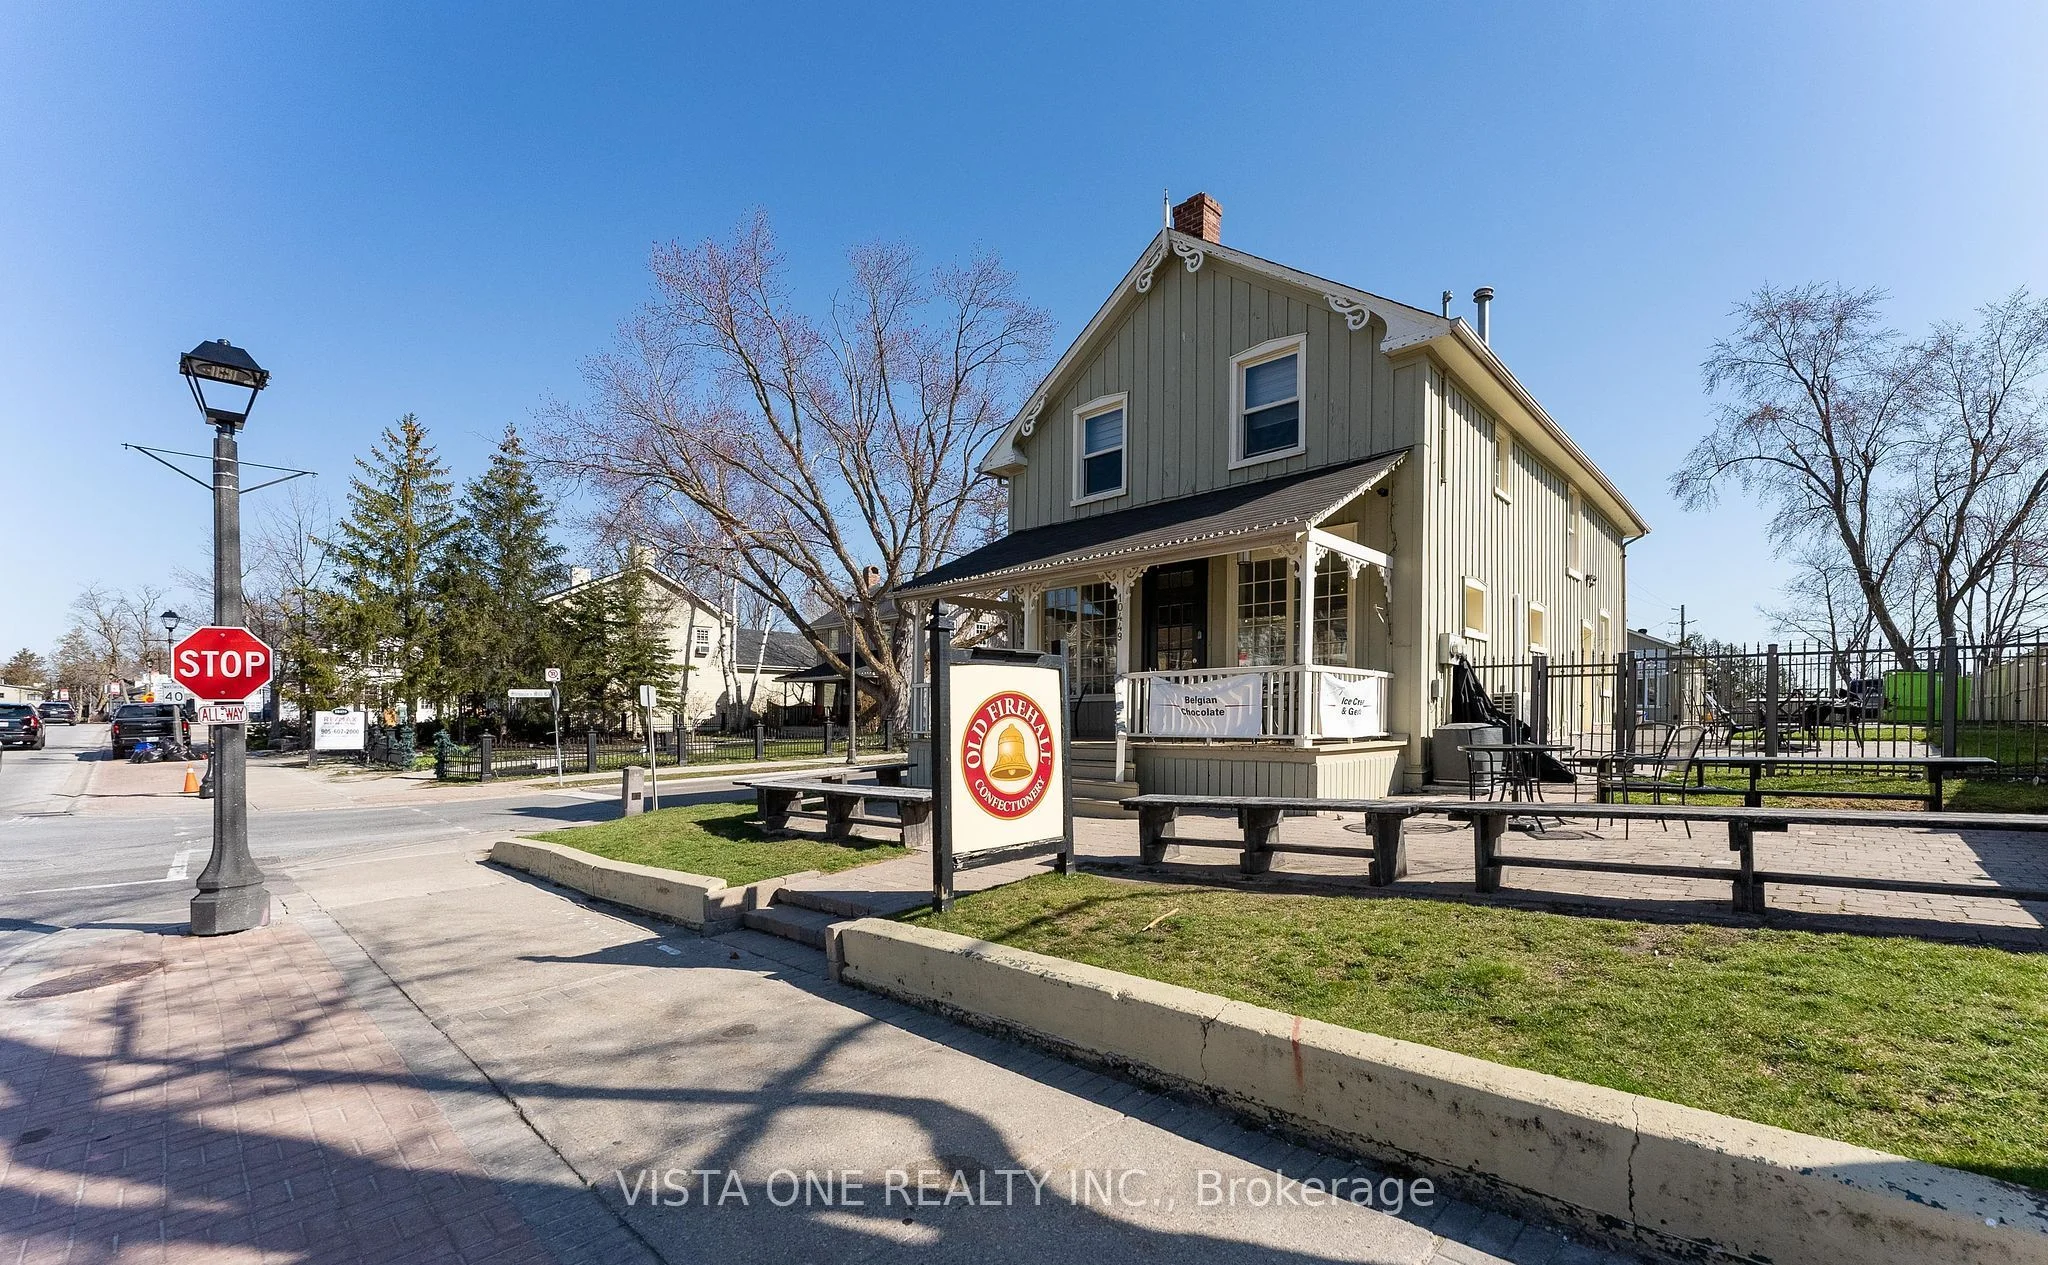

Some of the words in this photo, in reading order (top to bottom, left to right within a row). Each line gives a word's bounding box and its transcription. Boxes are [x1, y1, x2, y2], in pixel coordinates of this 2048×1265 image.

[179, 649, 266, 678] STOP
[165, 691, 183, 702] 40
[1184, 696, 1218, 706] Belgian
[1341, 696, 1353, 706] Ice
[1181, 708, 1225, 717] Chocolate
[1341, 706, 1347, 715] &
[966, 718, 988, 769] OLD
[986, 697, 1052, 766] FIREHALL
[974, 775, 1046, 812] CONFECTIONERY
